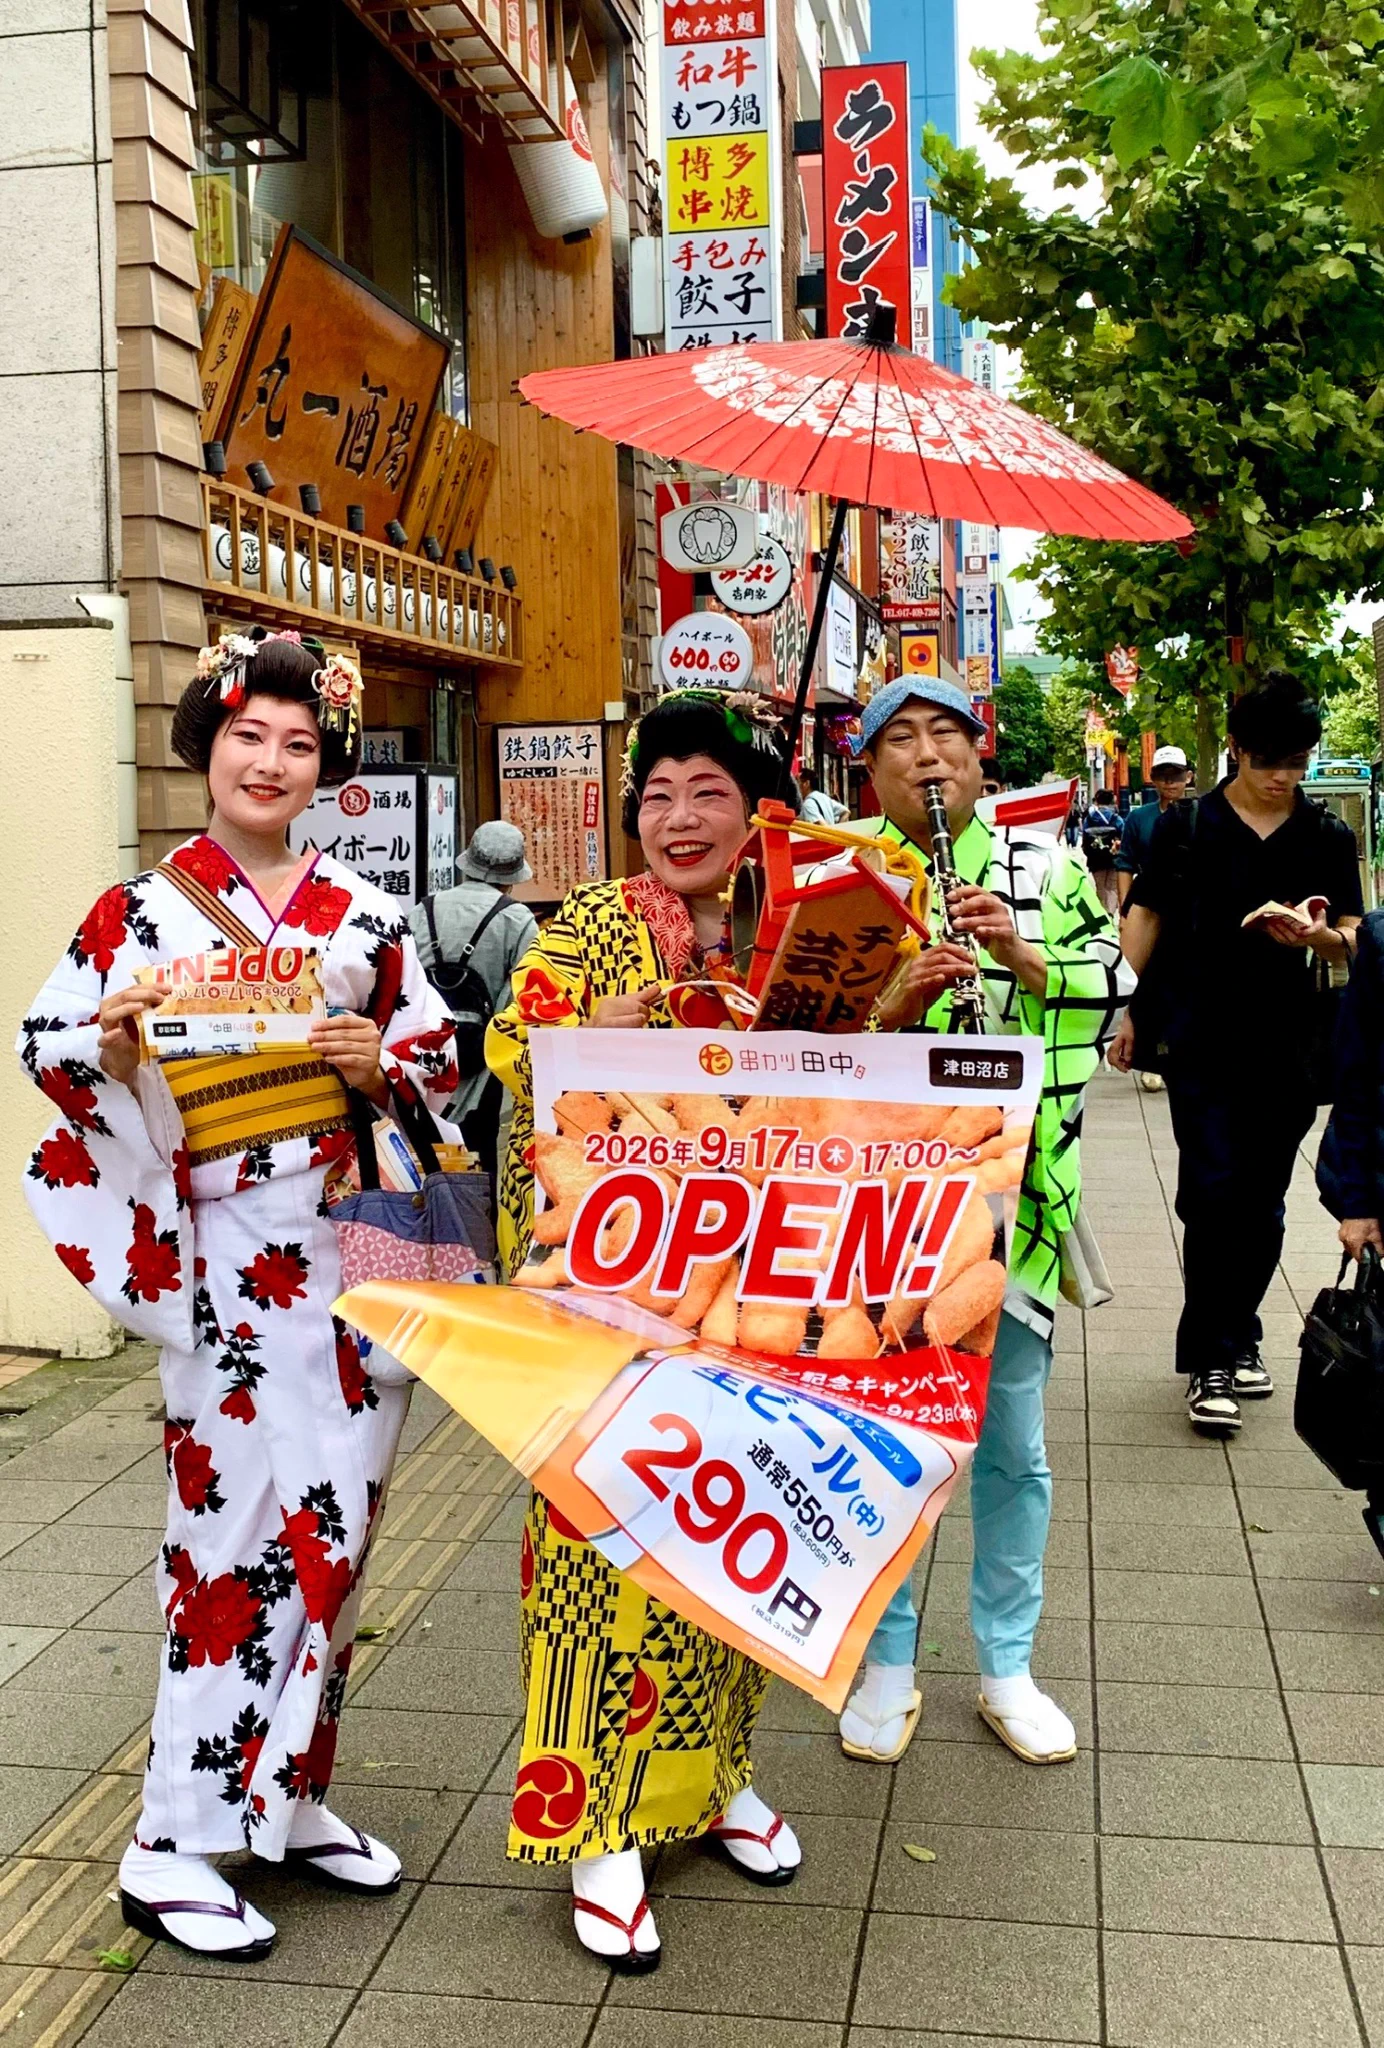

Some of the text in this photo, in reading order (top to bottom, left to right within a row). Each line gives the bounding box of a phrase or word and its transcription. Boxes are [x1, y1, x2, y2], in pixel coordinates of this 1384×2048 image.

[671, 11, 756, 39] 飲み放題
[675, 46, 758, 92] 和牛
[671, 94, 761, 129] もつ鍋
[678, 142, 757, 182] 博多
[677, 186, 759, 224] 串焼
[672, 237, 767, 271] 手包み
[675, 272, 766, 319] 餃子
[241, 324, 419, 493] 丸一酒場
[679, 630, 734, 643] ハイボール
[504, 734, 598, 762] 鉄鍋餃子
[739, 1049, 853, 1075] 串カツ田中
[943, 1058, 1010, 1080] 津田沼店
[585, 1126, 814, 1171] 2026年9月17日
[565, 1170, 975, 1307] OPEN!
[692, 1365, 885, 1538] 生ビール(中)
[746, 1438, 856, 1569] 通常550円が
[621, 1413, 823, 1638] 290円
[790, 1519, 831, 1568] (税込605円)
